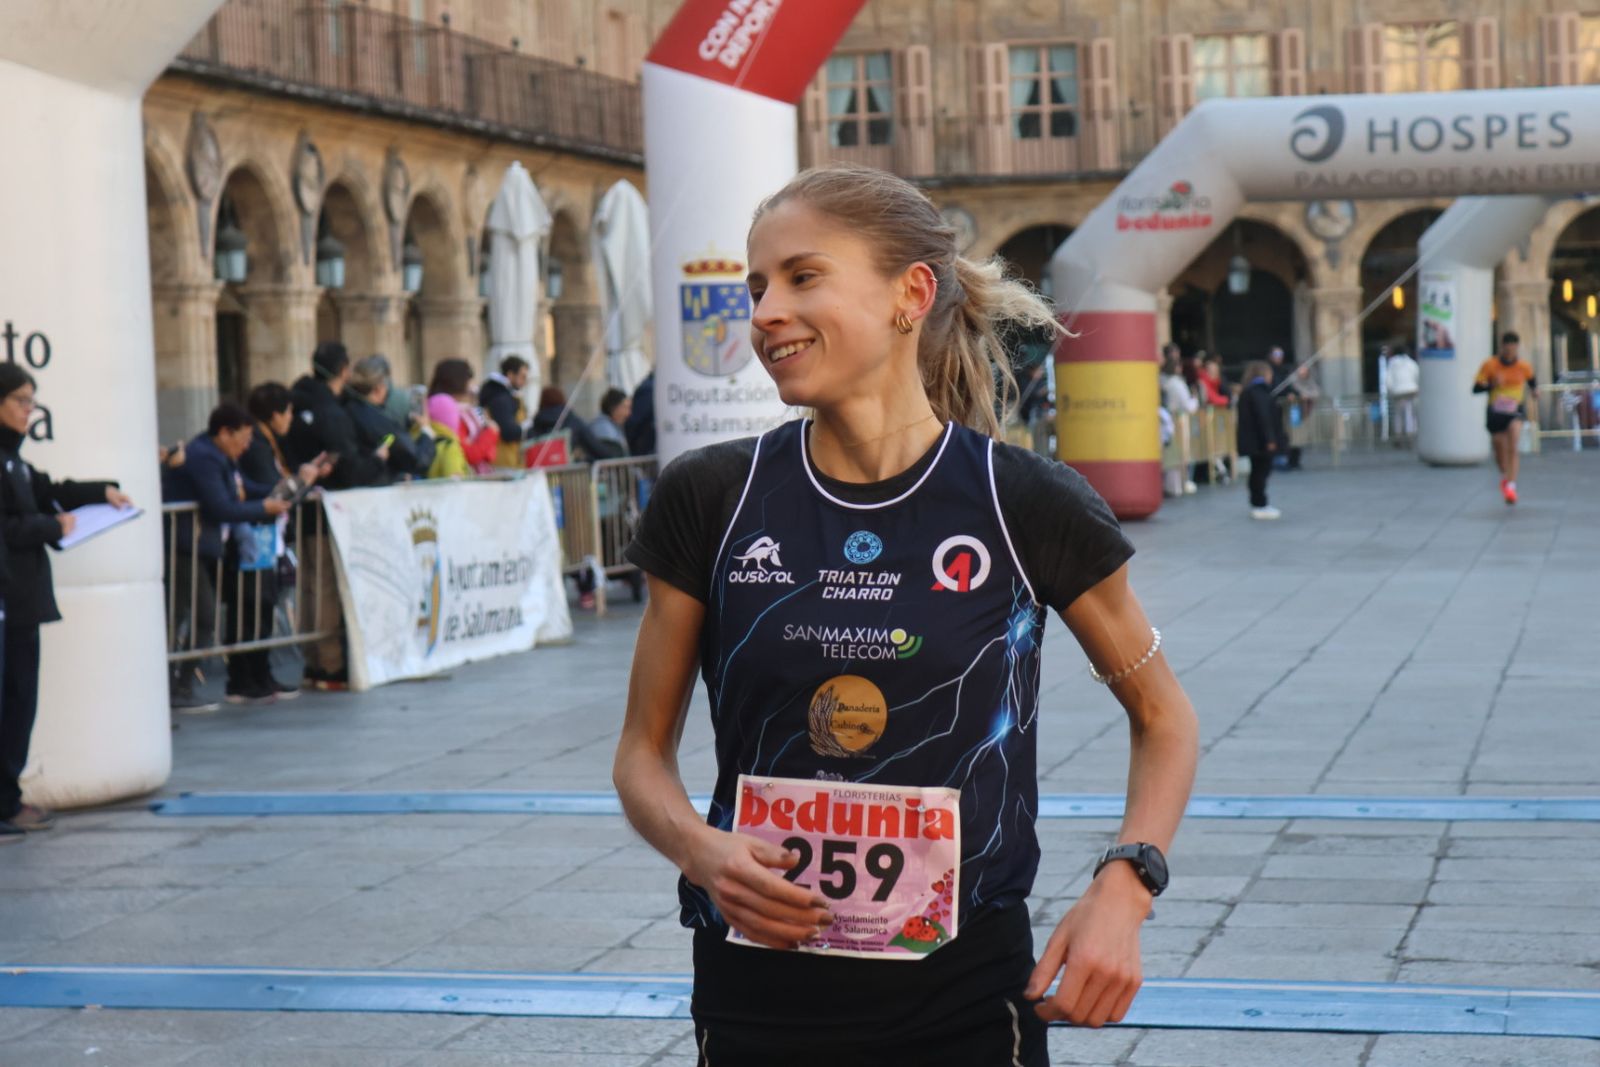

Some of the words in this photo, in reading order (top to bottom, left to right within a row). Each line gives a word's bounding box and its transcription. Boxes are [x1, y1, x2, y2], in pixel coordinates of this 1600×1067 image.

[698, 9, 741, 61] CON
[1367, 111, 1573, 153] HOSPES
[1294, 168, 1419, 191] PALACIO
[1427, 167, 1462, 188] DE
[1470, 164, 1527, 186] SAN
[1535, 161, 1600, 185] ESTE
[667, 382, 780, 407] Diputación
[728, 570, 796, 585] austral
[821, 586, 894, 601] CHARRO
[821, 643, 897, 660] TELECOM
[833, 788, 902, 802] FLORISTERÍAS
[738, 786, 955, 841] bedunia
[780, 836, 906, 903] 259
[832, 912, 889, 926] Ayuntamiento
[832, 923, 842, 933] de
[844, 923, 888, 936] Salamanca
